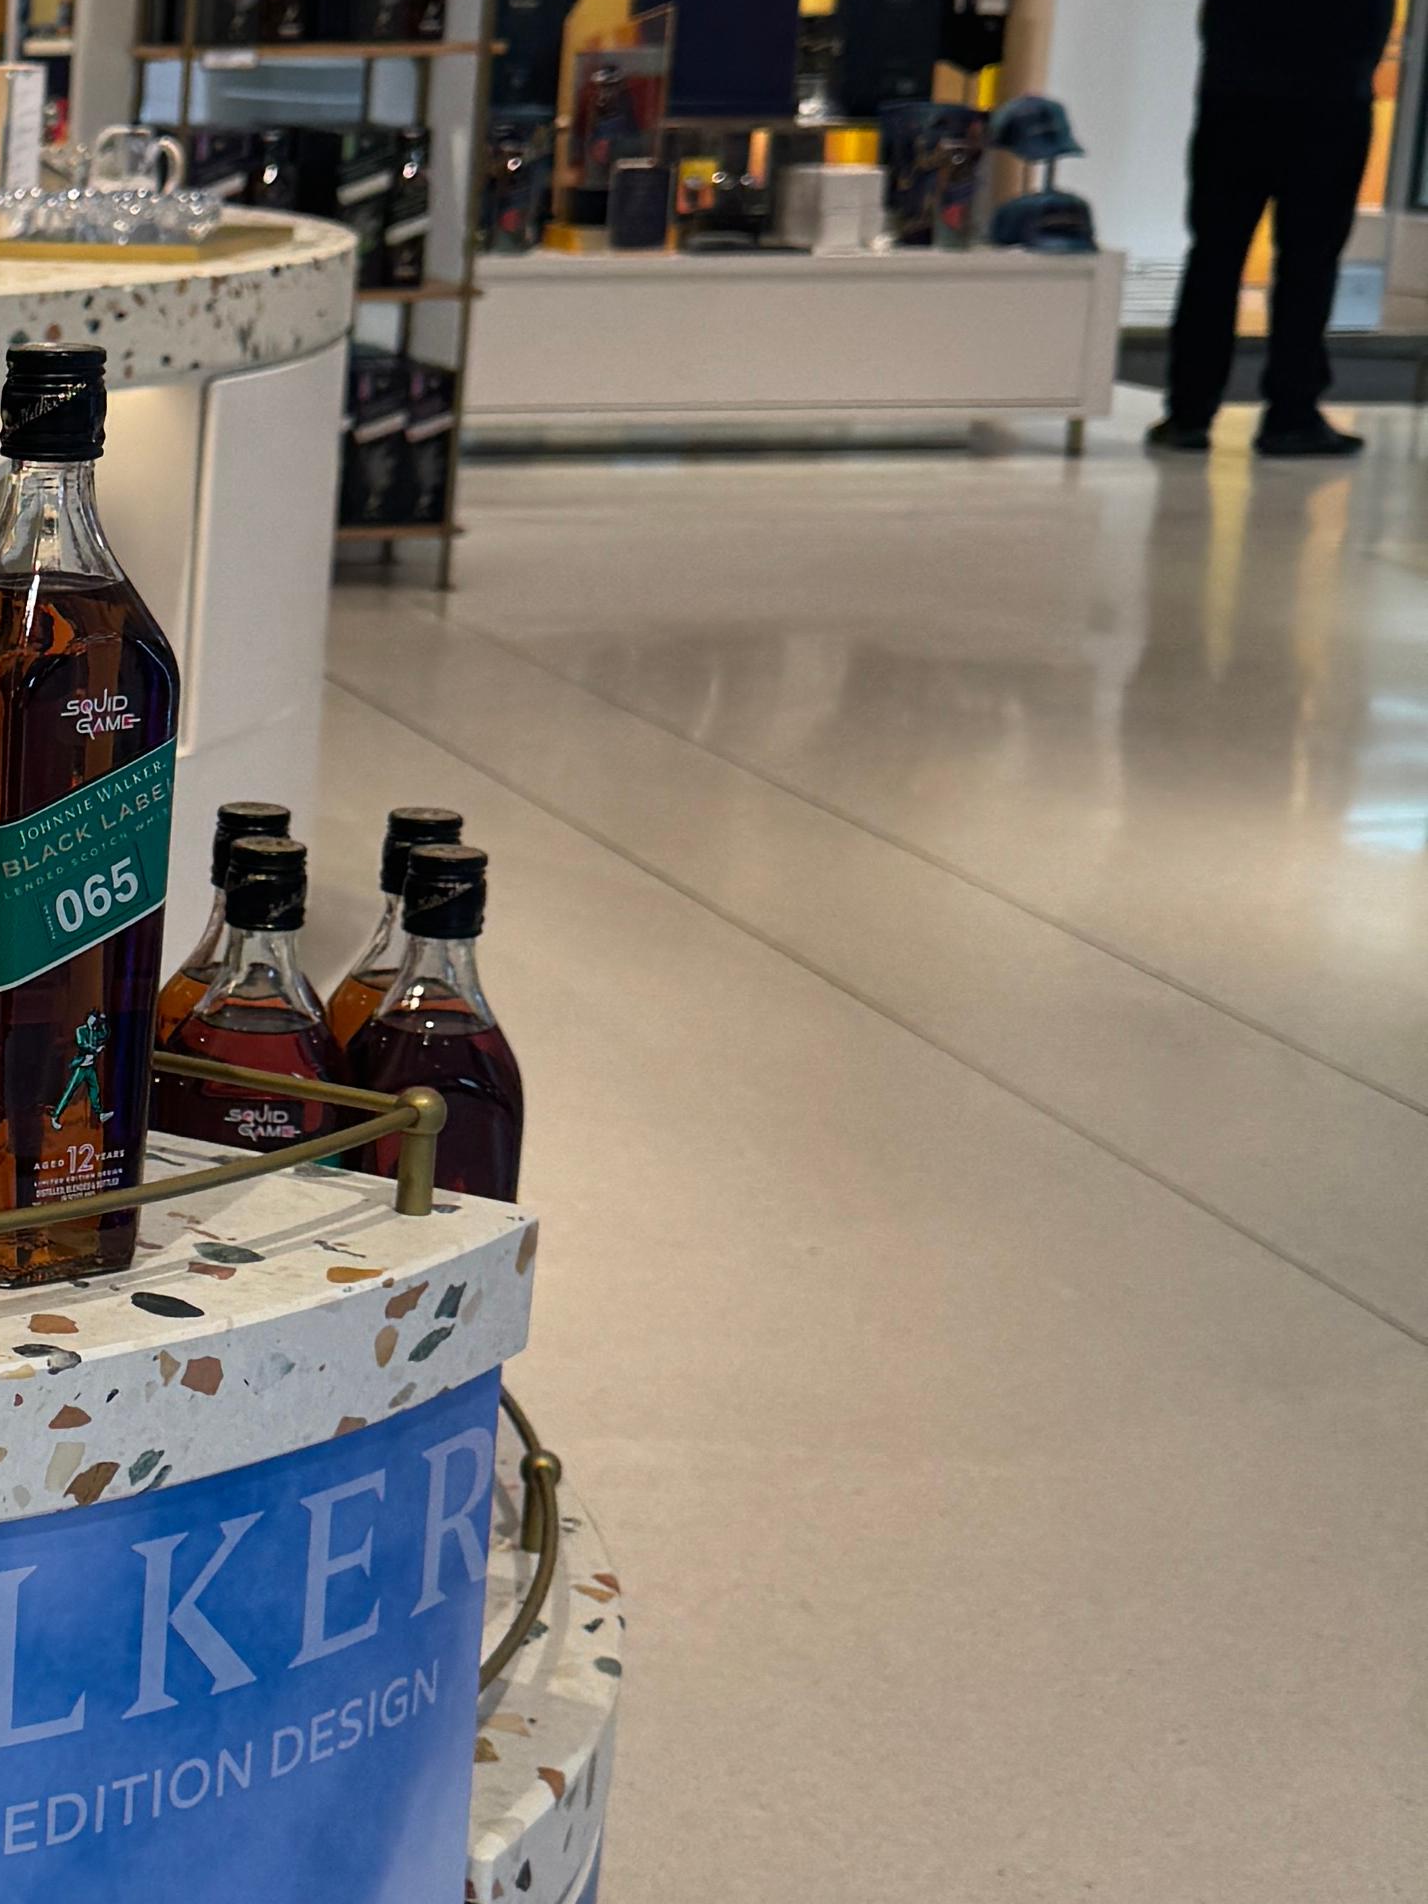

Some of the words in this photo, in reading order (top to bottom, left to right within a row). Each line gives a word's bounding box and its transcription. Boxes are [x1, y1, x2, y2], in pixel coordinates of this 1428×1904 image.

[61, 688, 128, 719] SQUID
[76, 713, 141, 740] GAME
[19, 799, 93, 849] JOHNNIE
[96, 760, 163, 803] WALKER
[2, 823, 92, 878] BLACK
[56, 857, 139, 933] 065
[224, 1104, 288, 1126] SQUID
[238, 1122, 301, 1142] GAME
[33, 1160, 64, 1170] AGED
[67, 1143, 95, 1174] 12
[95, 1149, 125, 1161] YEARS
[1, 1741, 254, 1856] EDITION
[269, 1658, 441, 1781] DESIGN
